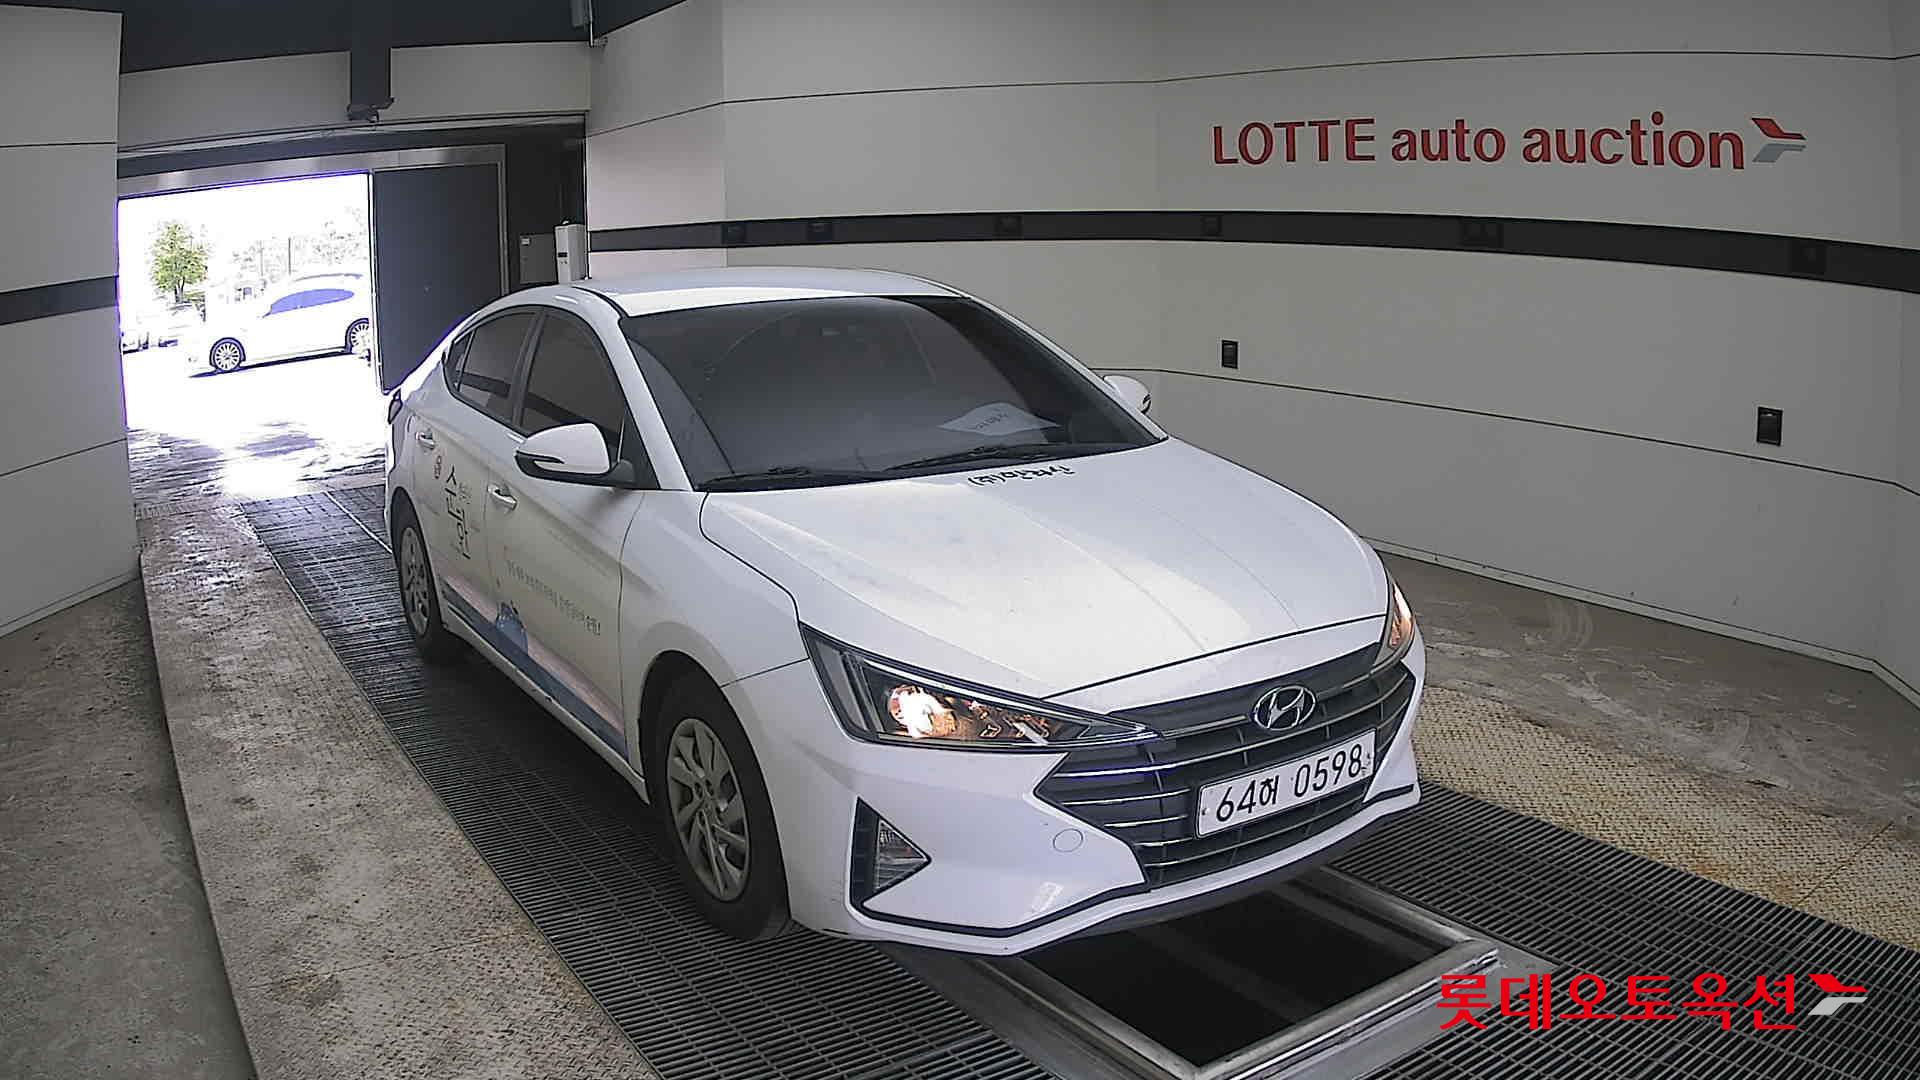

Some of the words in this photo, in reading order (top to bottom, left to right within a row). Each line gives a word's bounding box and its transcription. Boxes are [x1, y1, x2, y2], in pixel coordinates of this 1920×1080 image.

[1212, 117, 1377, 166] LOTTE
[1391, 118, 1506, 164] auto
[1522, 111, 1745, 170] auction
[1216, 776, 1279, 822] 64허
[1294, 743, 1363, 798] 0598
